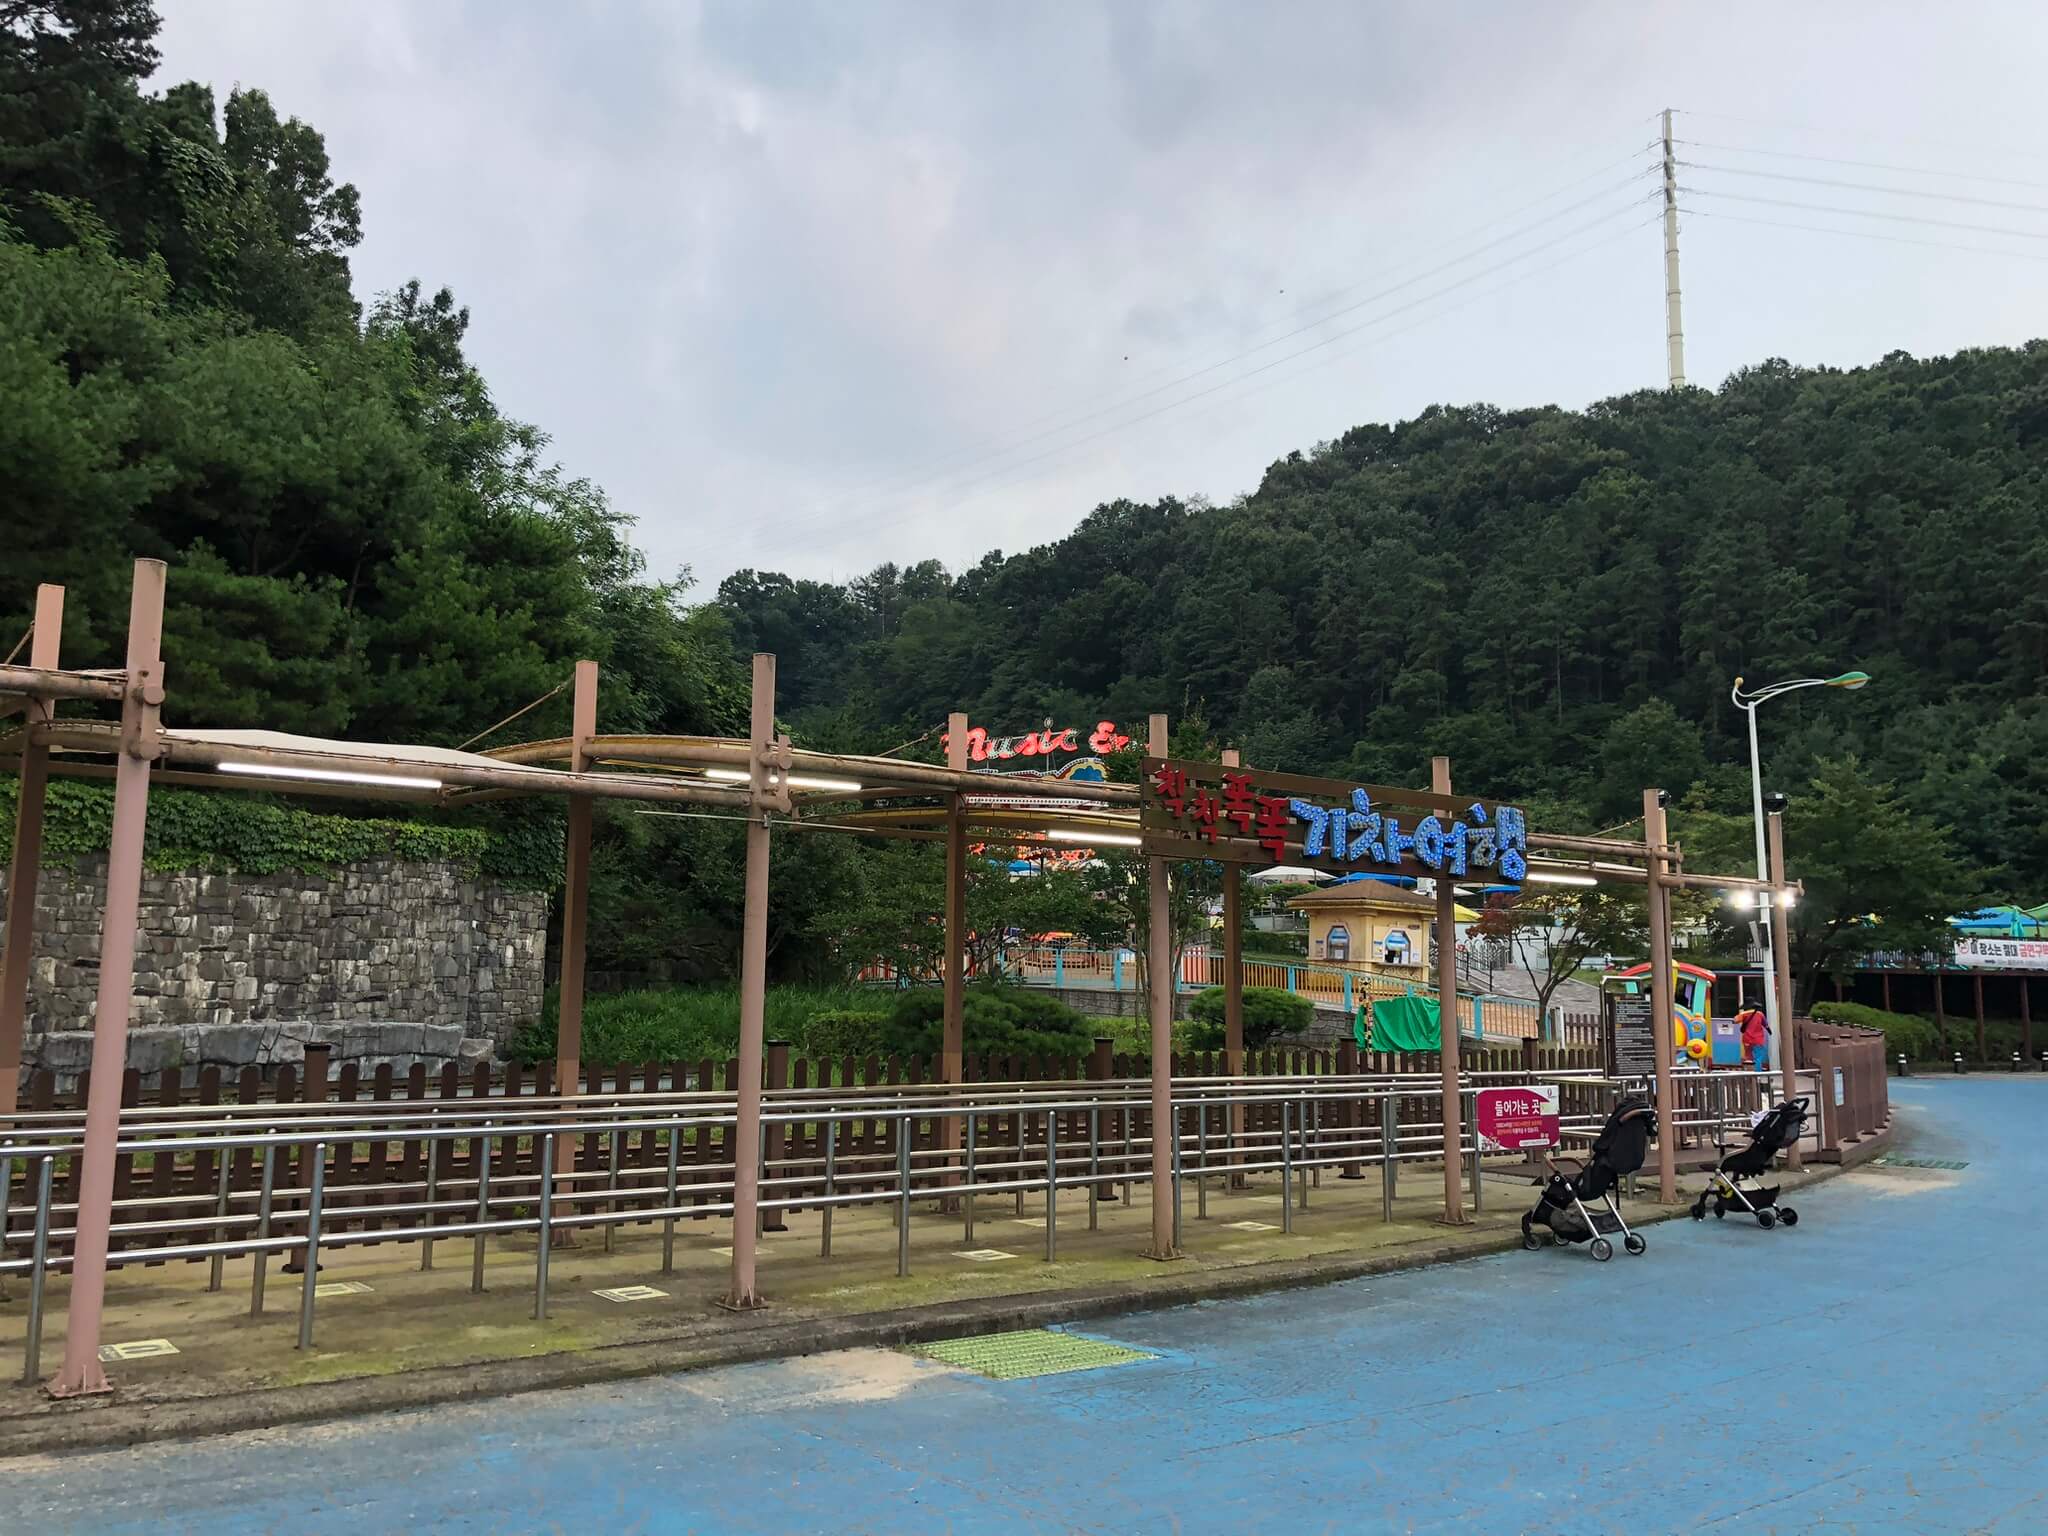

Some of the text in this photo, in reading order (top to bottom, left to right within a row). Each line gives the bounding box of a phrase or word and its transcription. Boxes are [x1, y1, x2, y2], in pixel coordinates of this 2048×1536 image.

[1154, 762, 1528, 881] 칙칙폭폭 기차여행
[1979, 942, 2002, 957] 장소는
[1495, 1099, 1541, 1117] 들어가는 곳
